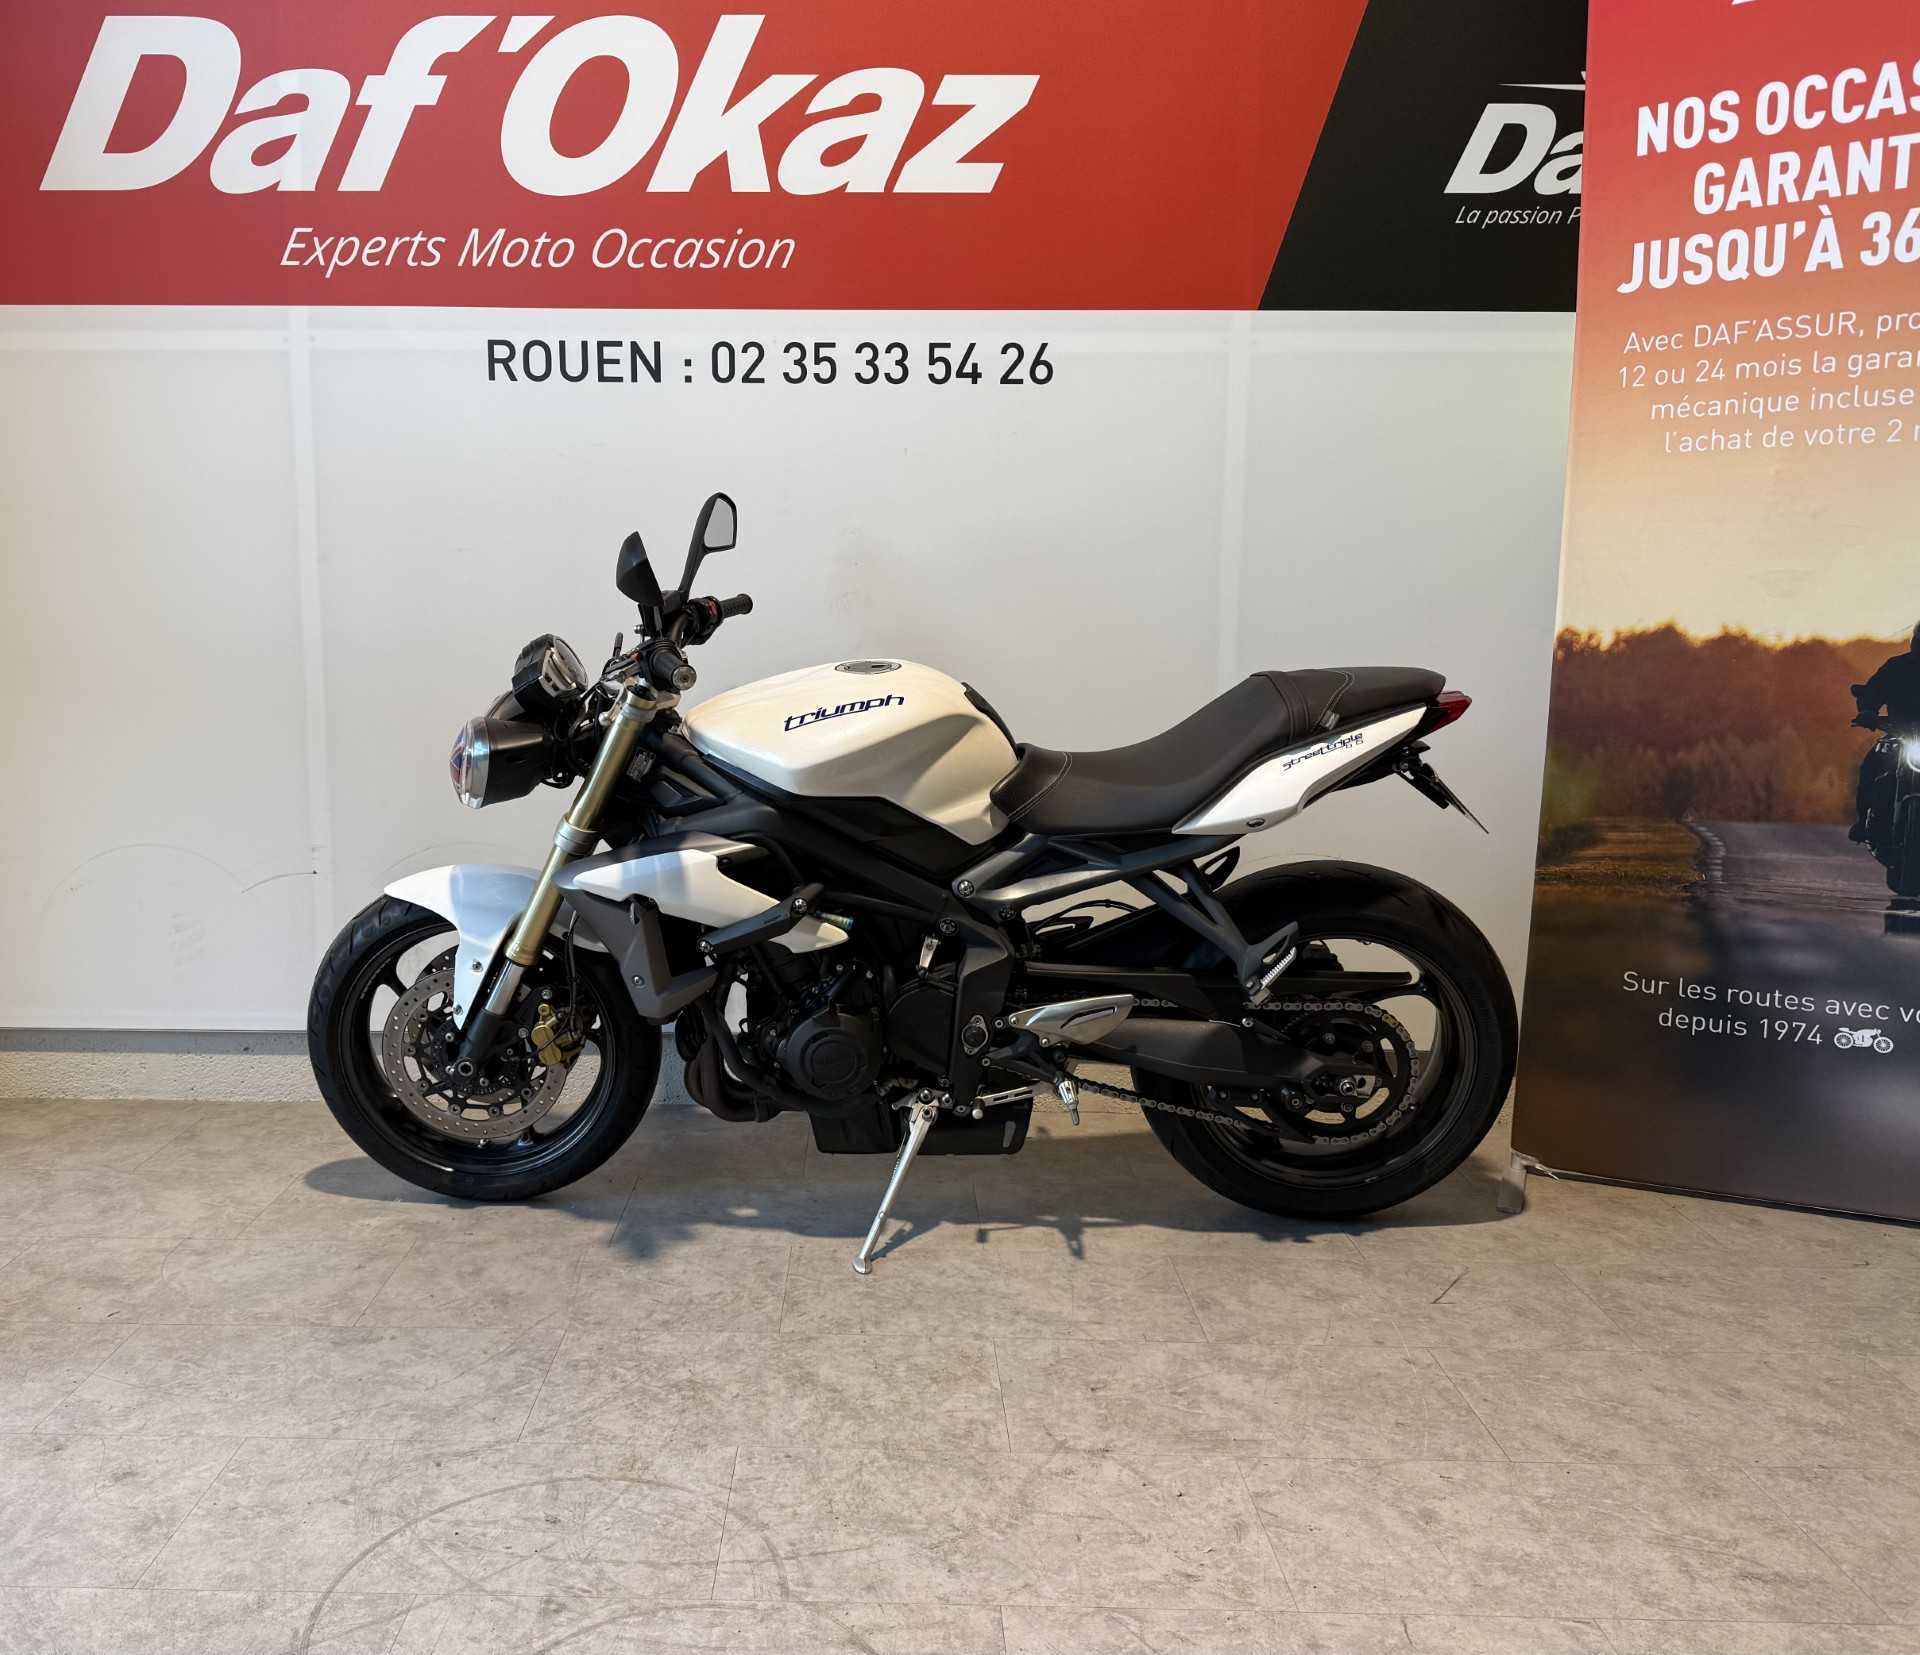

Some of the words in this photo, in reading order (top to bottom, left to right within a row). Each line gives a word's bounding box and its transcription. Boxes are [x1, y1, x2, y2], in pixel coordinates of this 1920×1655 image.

[1636, 90, 1739, 157] NOS
[1694, 134, 1920, 215] GARANT
[1455, 206, 1481, 224] La
[1481, 206, 1563, 229] passion
[280, 227, 446, 278] Experts
[457, 227, 575, 268] Moto
[591, 227, 796, 269] Occasion
[1616, 205, 1844, 294] JUSQU'À
[1860, 208, 1920, 266] 36
[1624, 331, 1684, 354] Avec
[1695, 311, 1864, 348] DAF'ASSUR,
[488, 339, 662, 384] ROUEN
[685, 358, 693, 384] :
[711, 340, 766, 384] 02
[782, 341, 837, 385] 35
[854, 341, 909, 385] 33
[927, 342, 983, 385] 54
[999, 342, 1054, 385] 26
[1619, 365, 1646, 388] 12
[1654, 367, 1685, 386] ou
[1695, 359, 1726, 383] 24
[1736, 353, 1802, 379] mois
[1812, 351, 1836, 374] la
[1847, 350, 1920, 378] gara
[1651, 391, 1800, 421] mécanique
[1810, 385, 1915, 411] incluse
[1665, 429, 1753, 453] l'achat
[1762, 426, 1795, 449] de
[1804, 424, 1876, 446] votre
[1886, 418, 1903, 443] 2
[784, 694, 904, 732] triumph
[1623, 971, 1670, 995] Sur
[1678, 977, 1717, 1001] les
[1727, 988, 1816, 1012] routes
[1825, 1000, 1890, 1021] avec
[1658, 1008, 1747, 1036] depuis
[1760, 1018, 1823, 1045] 1974
